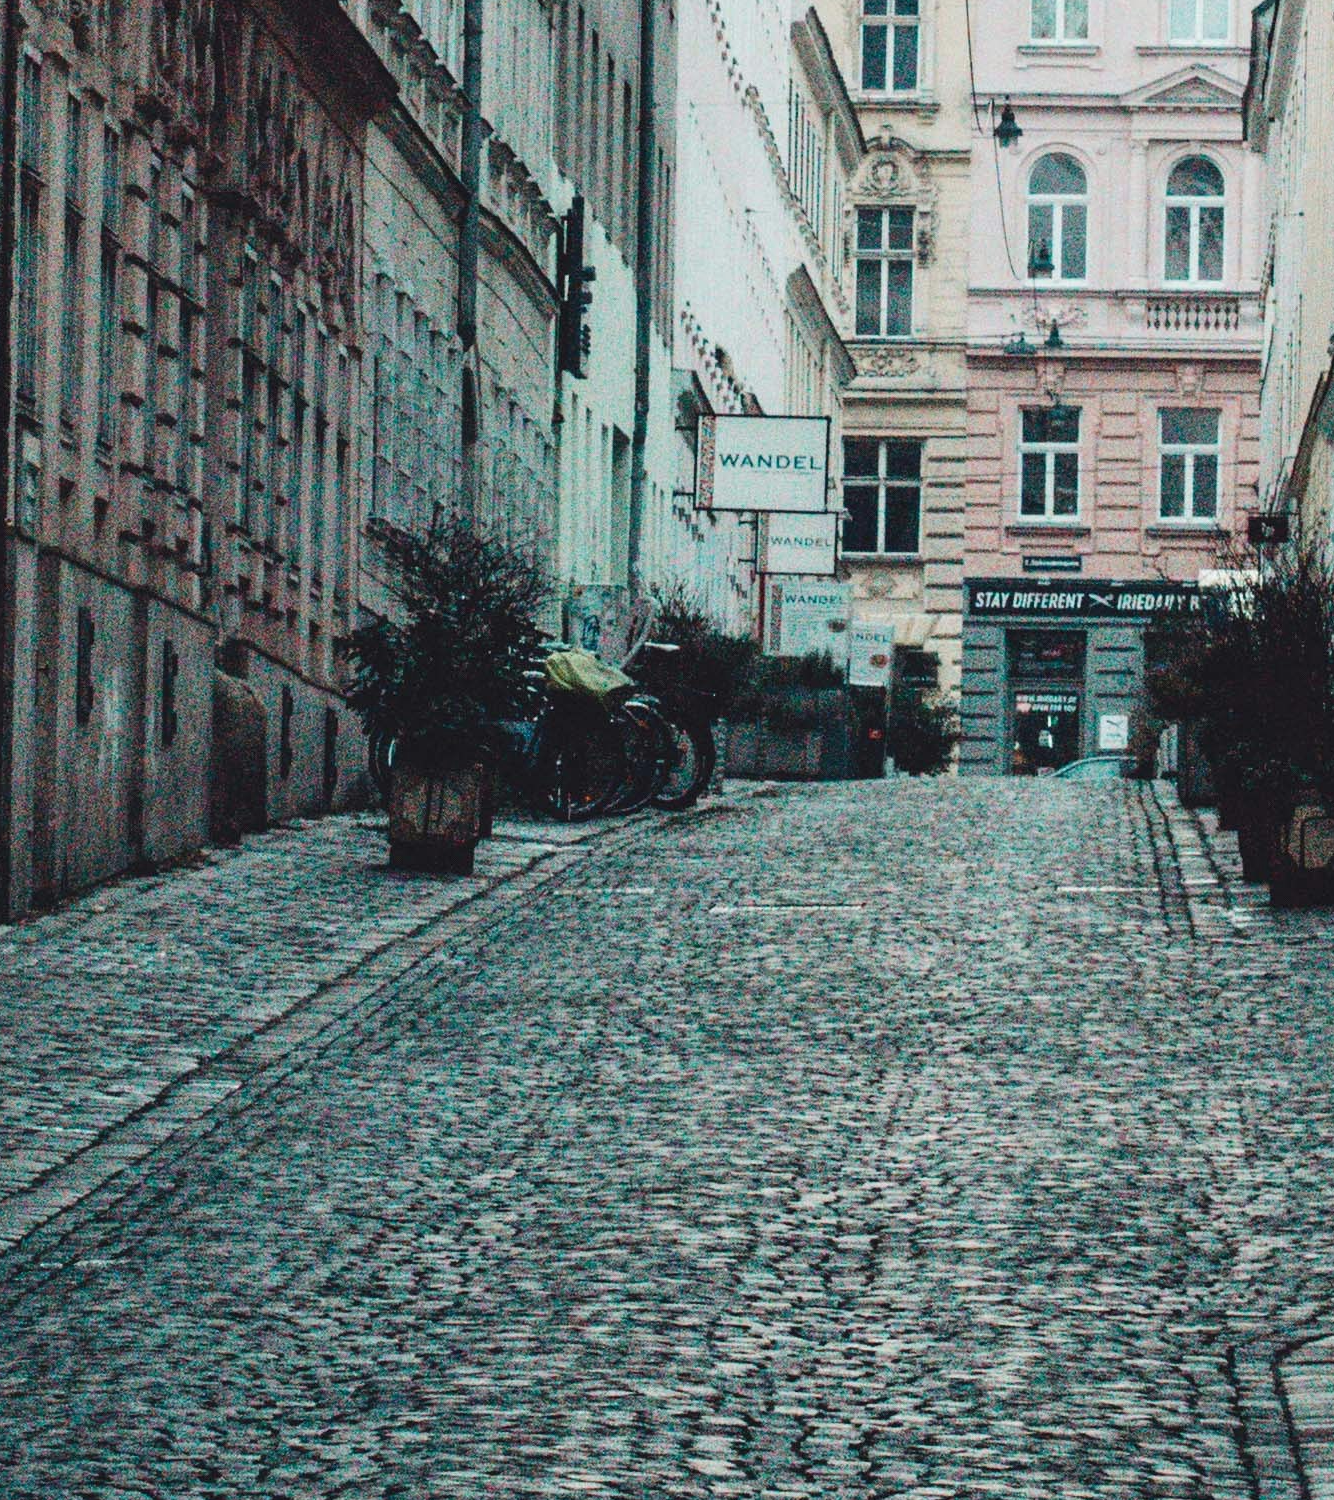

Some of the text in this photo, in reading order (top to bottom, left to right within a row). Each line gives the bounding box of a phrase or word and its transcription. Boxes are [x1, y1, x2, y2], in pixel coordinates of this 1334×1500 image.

[719, 454, 822, 470] WANDEL
[770, 536, 833, 548] WANDEL
[784, 594, 845, 605] WANDEL
[975, 592, 1009, 609] STAY
[1012, 592, 1084, 610] DIFFERENT
[851, 632, 889, 644] NDEL
